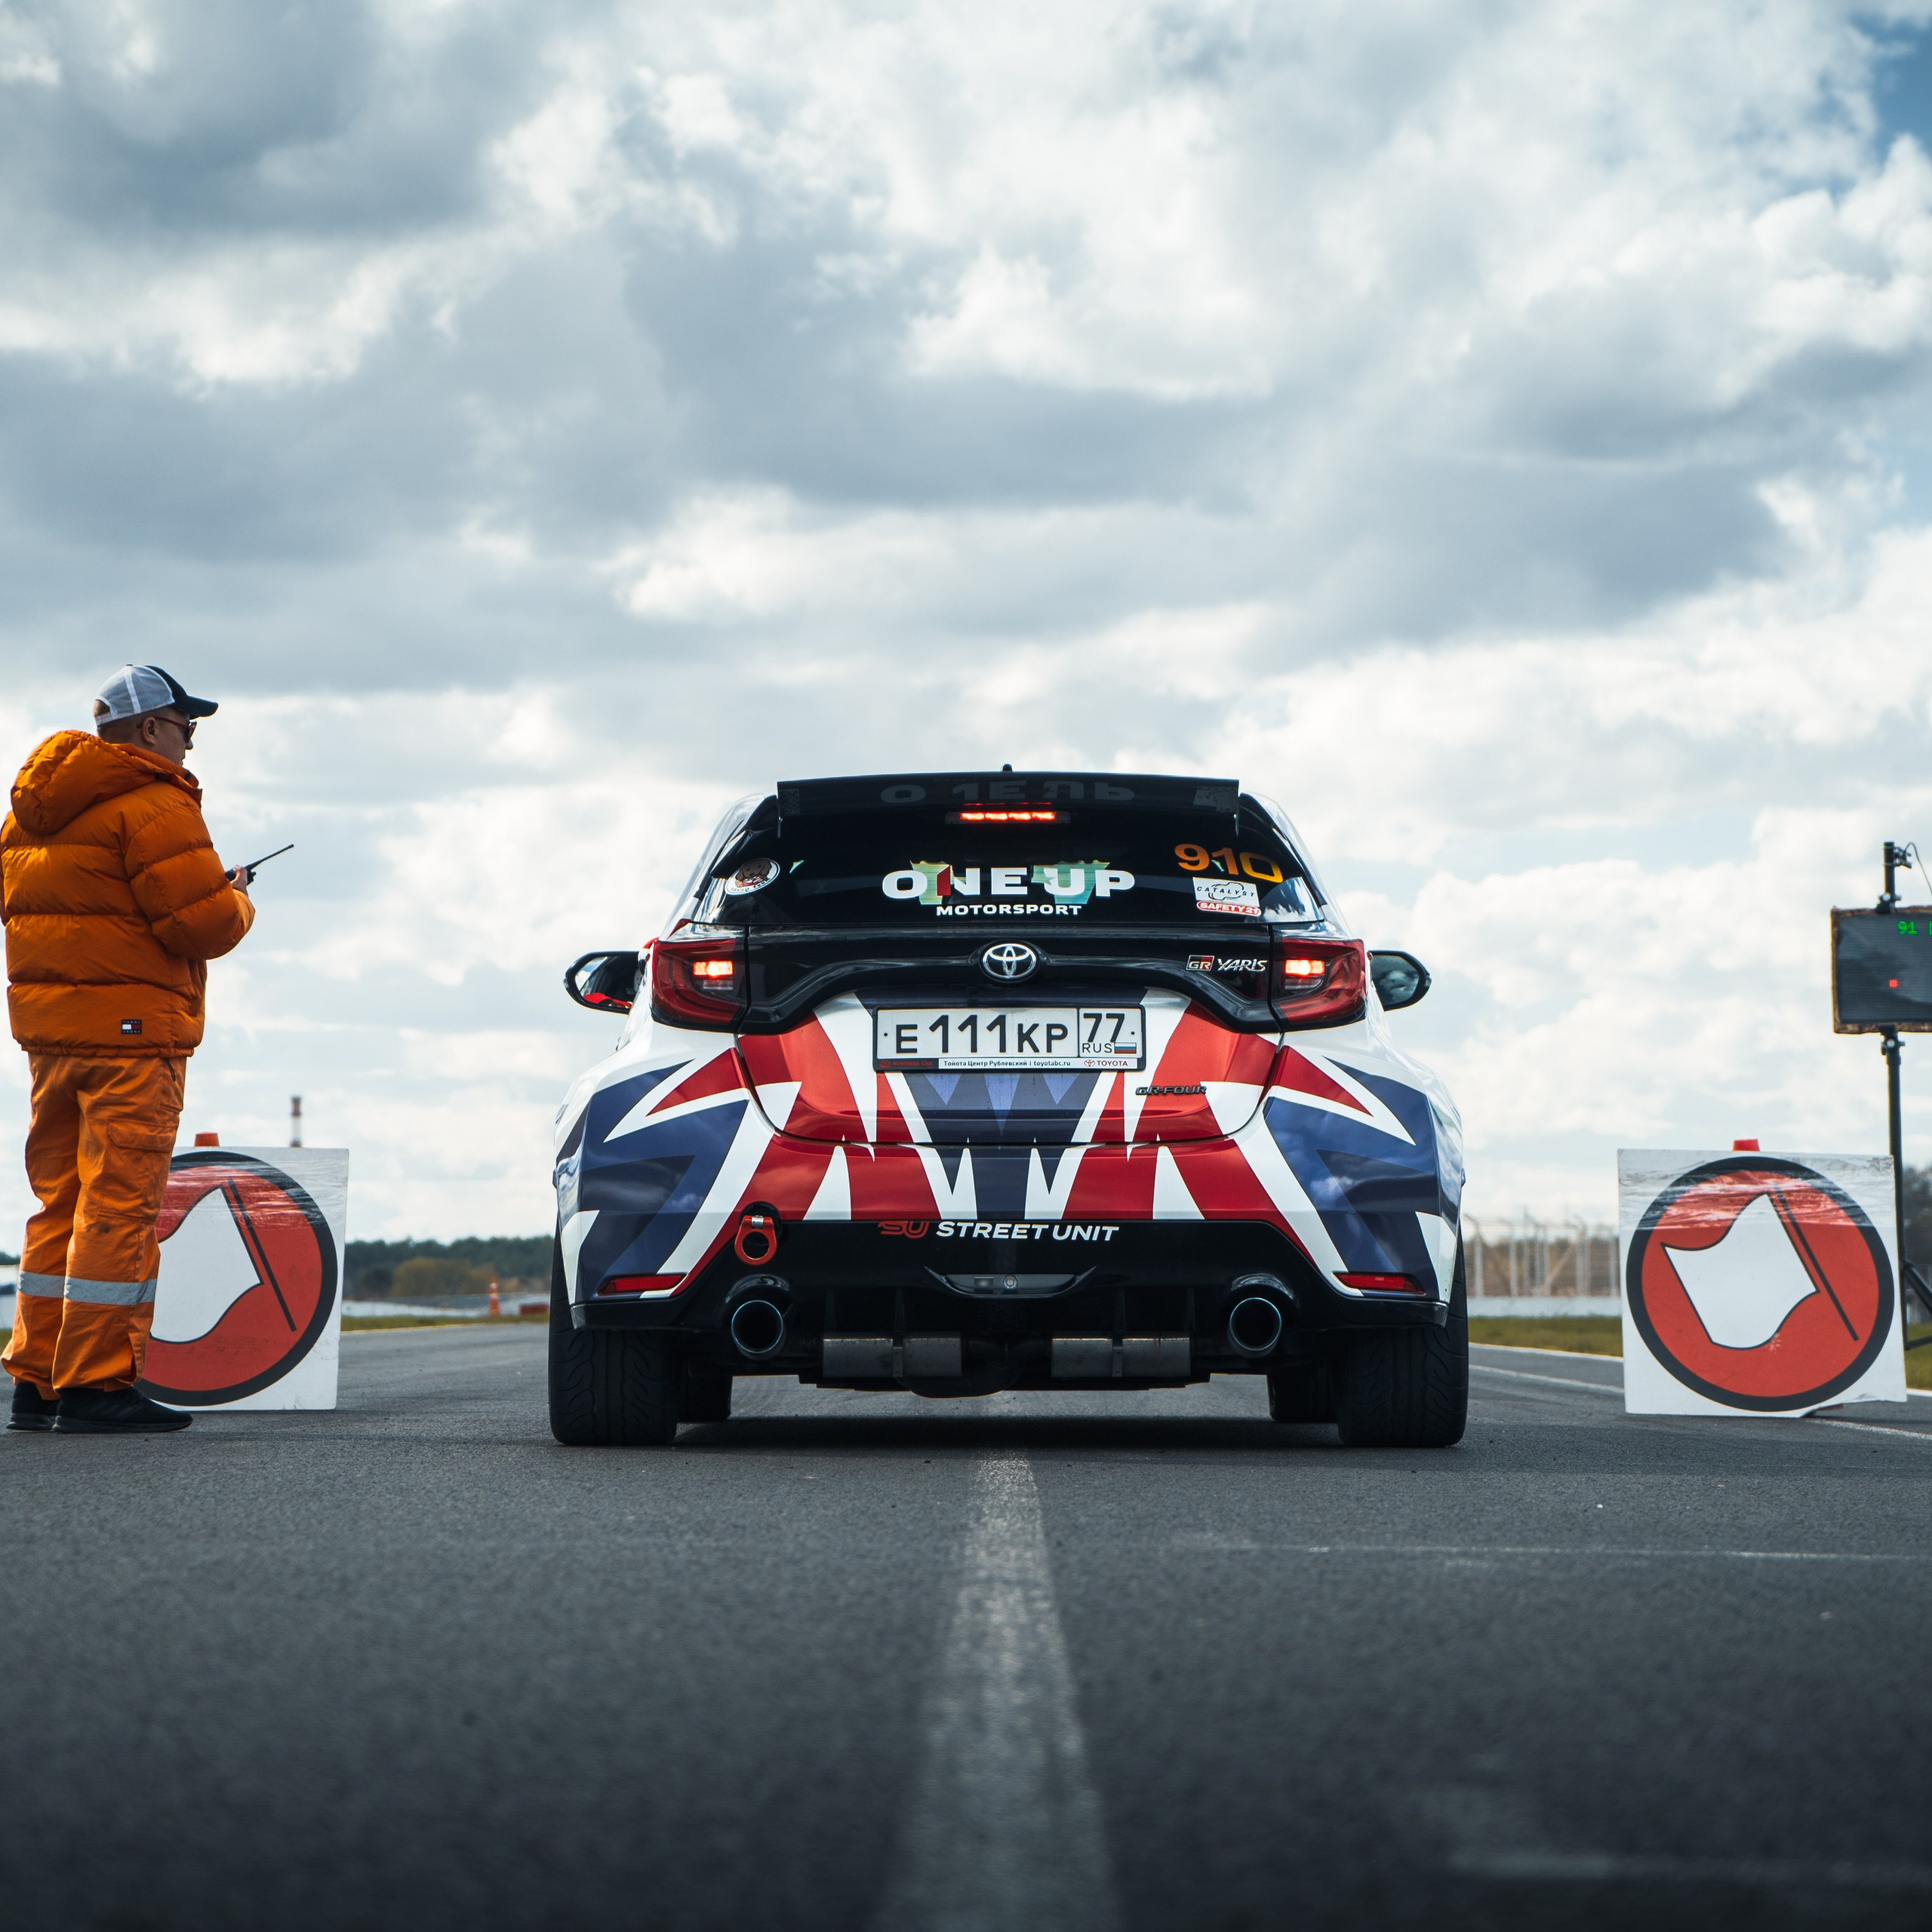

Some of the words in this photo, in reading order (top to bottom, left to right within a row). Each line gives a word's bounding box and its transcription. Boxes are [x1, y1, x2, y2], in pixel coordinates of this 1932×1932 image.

[1174, 843, 1284, 883] 910
[1196, 886, 1255, 897] CATALYST
[936, 904, 1082, 916] MOTORSPORT
[1188, 961, 1211, 970] GR
[1083, 1013, 1125, 1042] 77
[1081, 1043, 1112, 1054] RUS
[989, 1059, 1028, 1067] Рублевский
[936, 1221, 1049, 1239] STREET
[1052, 1224, 1119, 1241] UNIT
